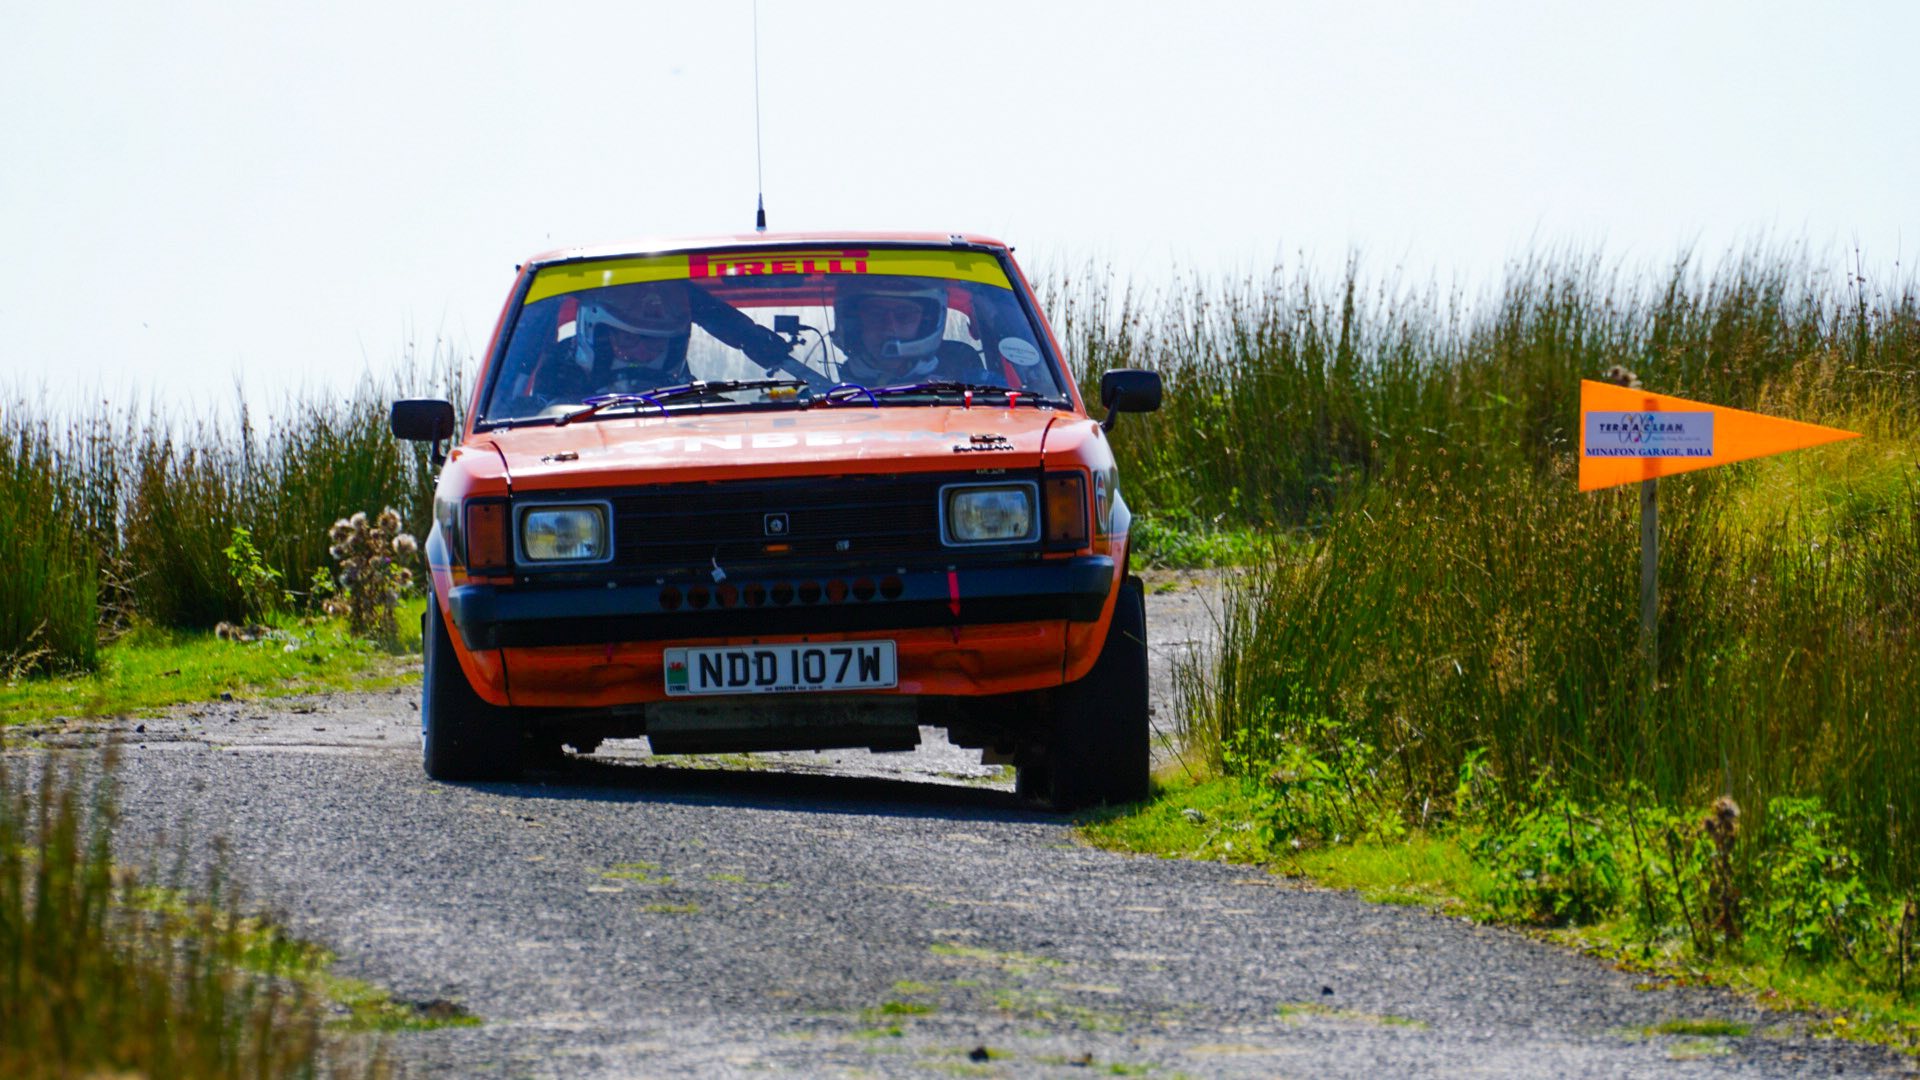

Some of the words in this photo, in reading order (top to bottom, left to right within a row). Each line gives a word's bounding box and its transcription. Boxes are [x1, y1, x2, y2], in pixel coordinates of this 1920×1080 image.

[688, 250, 869, 279] PIRELLI
[1586, 447, 1636, 456] MINAFON
[1638, 447, 1684, 457] GARAGE,
[1686, 447, 1712, 456] BALA
[699, 650, 777, 688] NDD
[791, 646, 881, 685] 107W
